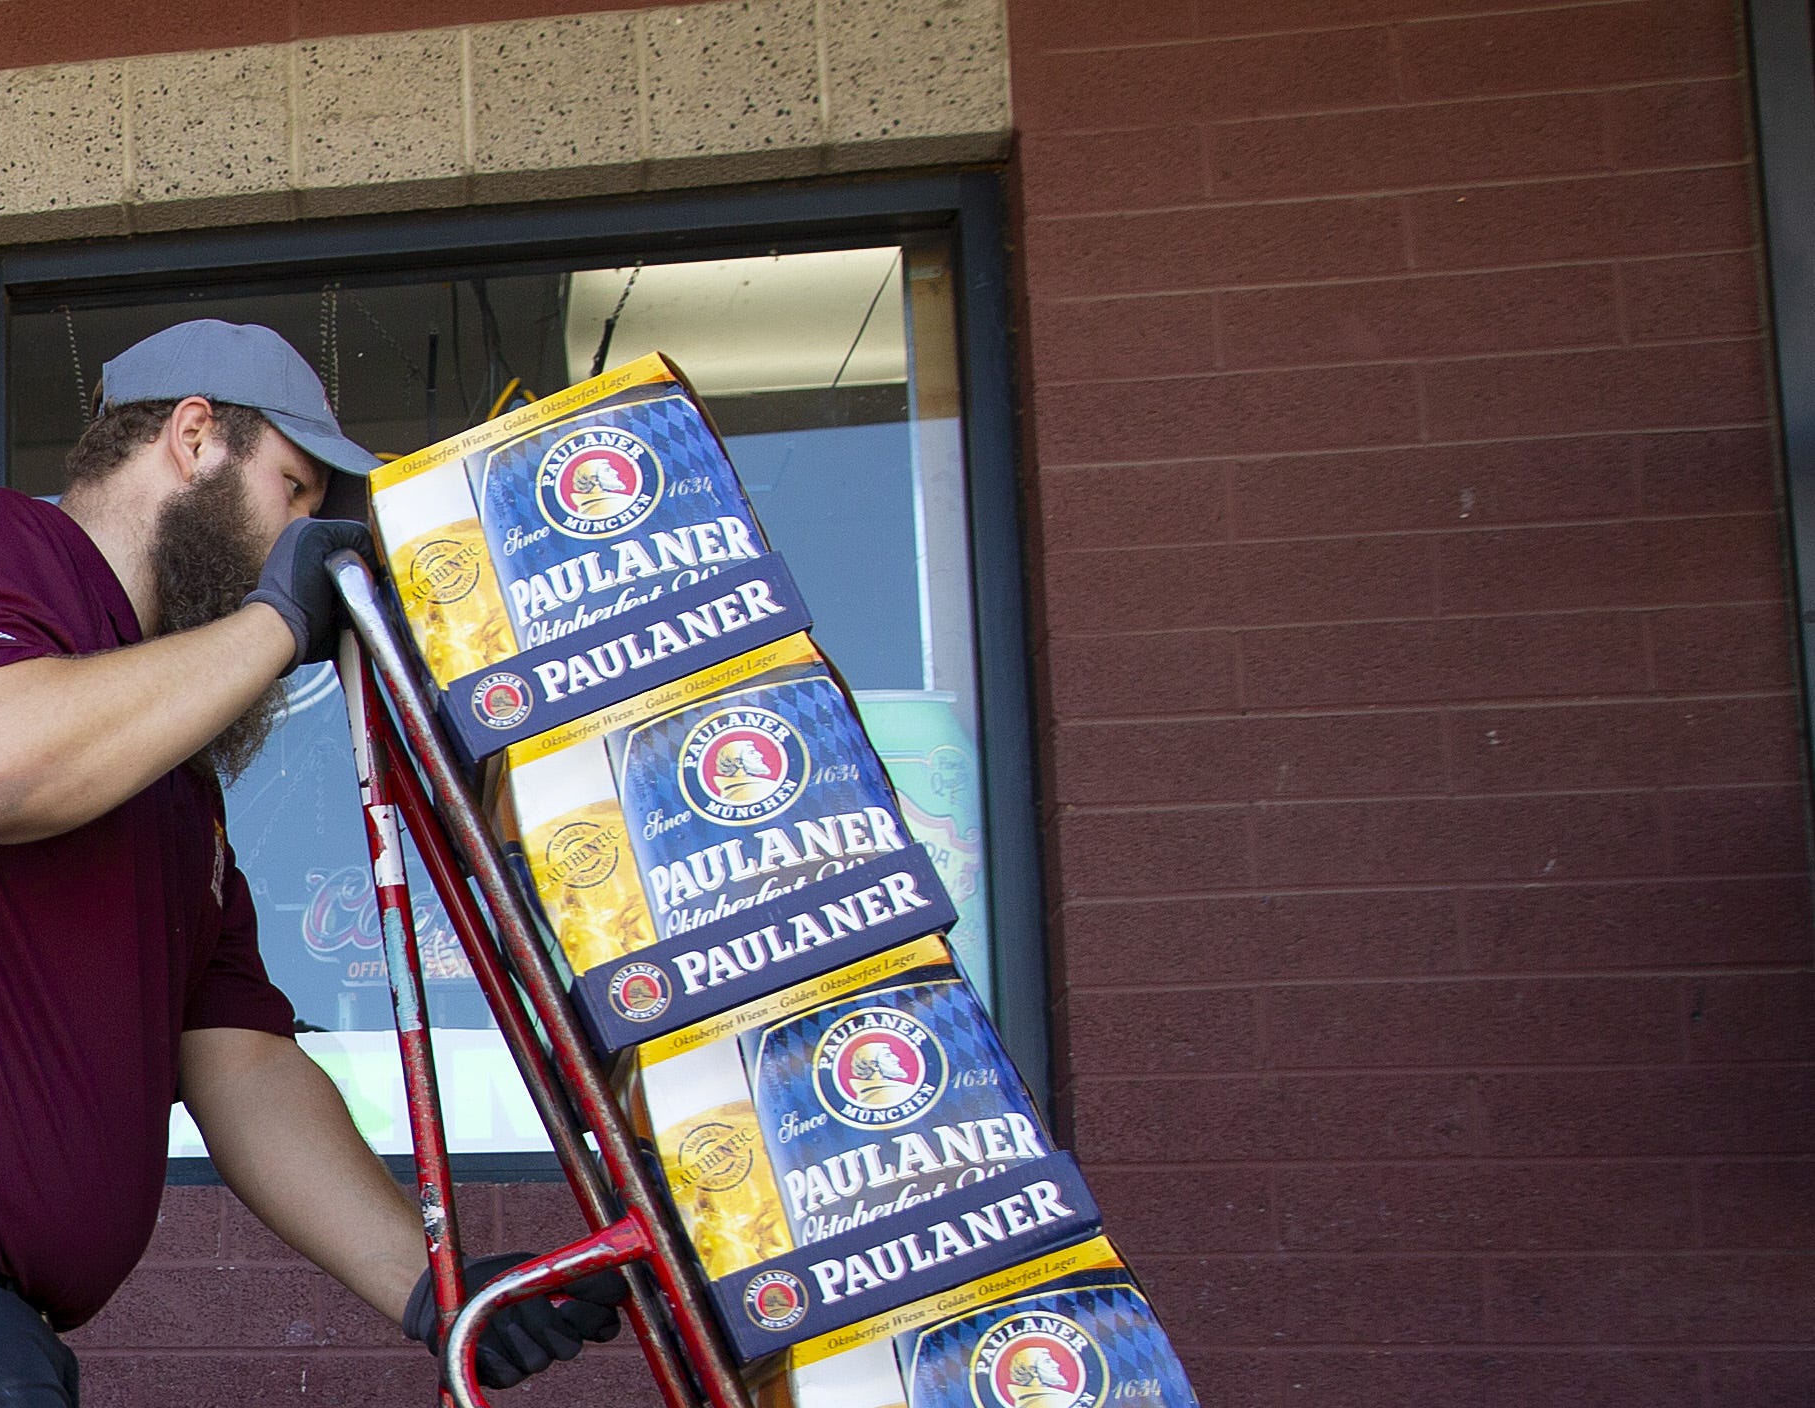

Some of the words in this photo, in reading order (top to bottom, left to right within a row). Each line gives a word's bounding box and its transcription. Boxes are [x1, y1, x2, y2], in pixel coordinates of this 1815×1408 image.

[401, 442, 460, 476] Oktoberfest
[501, 408, 539, 432] Golden
[539, 383, 601, 418] Oktoberfest
[599, 369, 635, 393] Lager
[541, 433, 645, 487] PAULANER
[501, 525, 553, 556] Since
[665, 476, 711, 498] 1634
[562, 491, 652, 532] MÜNCHEN
[410, 542, 480, 601] AUTHENTIC
[509, 512, 757, 625] PAULANER
[533, 577, 785, 703] PAULANER
[474, 672, 522, 705] PAULANER
[540, 718, 601, 752] Oktoberfest
[643, 687, 683, 709] Golden
[683, 663, 746, 696] Oktoberfest
[745, 649, 781, 673] Lager
[683, 712, 791, 769] PAULANER
[641, 809, 695, 841] Since
[811, 764, 859, 785] 1634
[705, 777, 798, 818] MÜNCHEN
[546, 825, 619, 884] AUTHENTIC
[648, 802, 903, 913] PAULANER
[671, 868, 931, 995] PAULANER
[612, 963, 661, 996] PAULANER
[671, 1017, 734, 1051] Oktoberfest
[778, 985, 818, 1009] Golden
[818, 962, 884, 996] Oktoberfest
[882, 949, 919, 972] Lager
[818, 1014, 927, 1070] PAULANER
[776, 1112, 831, 1144] Since
[950, 1069, 998, 1089] 1634
[840, 1081, 936, 1122] MÜNCHEN
[678, 1127, 753, 1187] AUTHENTIC
[784, 1107, 1045, 1219] PAULANER
[808, 1177, 1075, 1304] PAULANER
[747, 1270, 798, 1304] PAULANER
[825, 1319, 891, 1352] Oktoberfest
[935, 1289, 976, 1311] Golden
[977, 1266, 1043, 1299] Oktoberfest
[1042, 1253, 1079, 1276] Lager
[975, 1317, 1089, 1375] PAULANER
[1111, 1379, 1161, 1400] 1634
